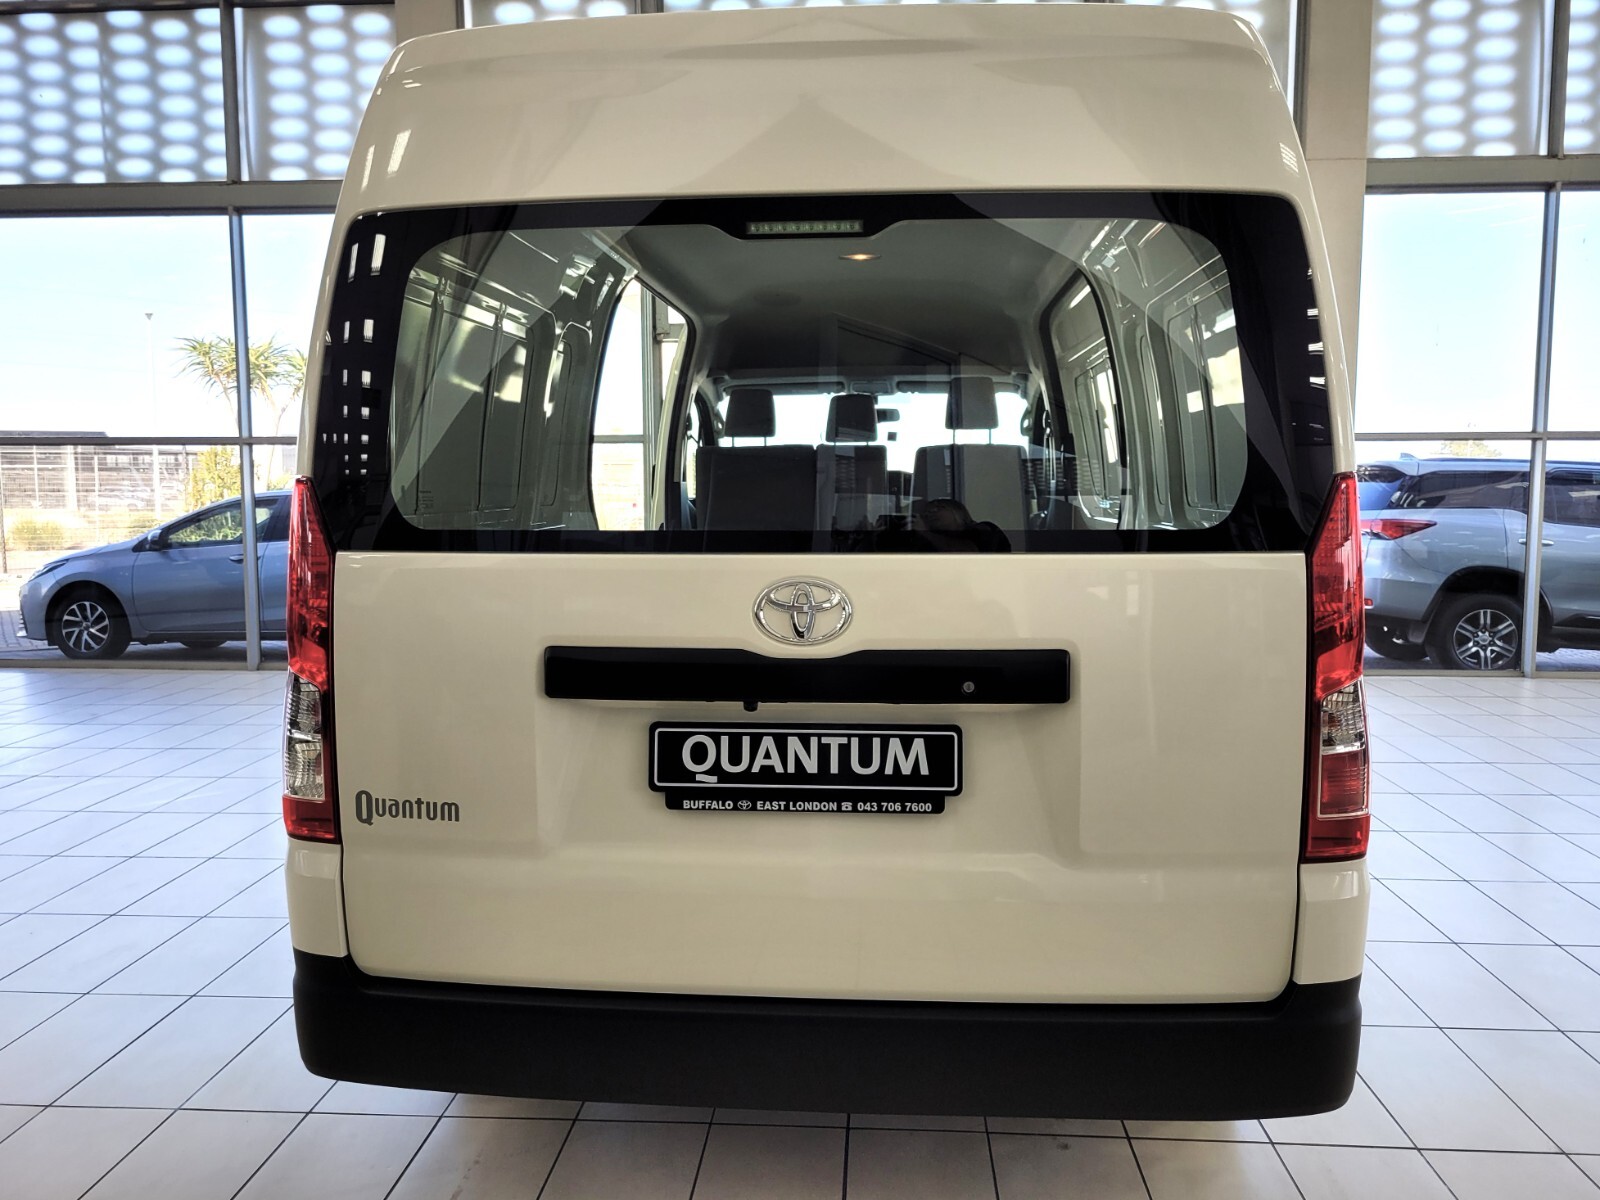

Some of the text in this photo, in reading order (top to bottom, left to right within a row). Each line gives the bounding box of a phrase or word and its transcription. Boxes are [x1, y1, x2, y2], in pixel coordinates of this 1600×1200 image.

[682, 735, 929, 783] QUANTUM
[355, 790, 460, 826] Quantum
[683, 800, 932, 813] BUFFALO EAST LONDON 043 706 7600
